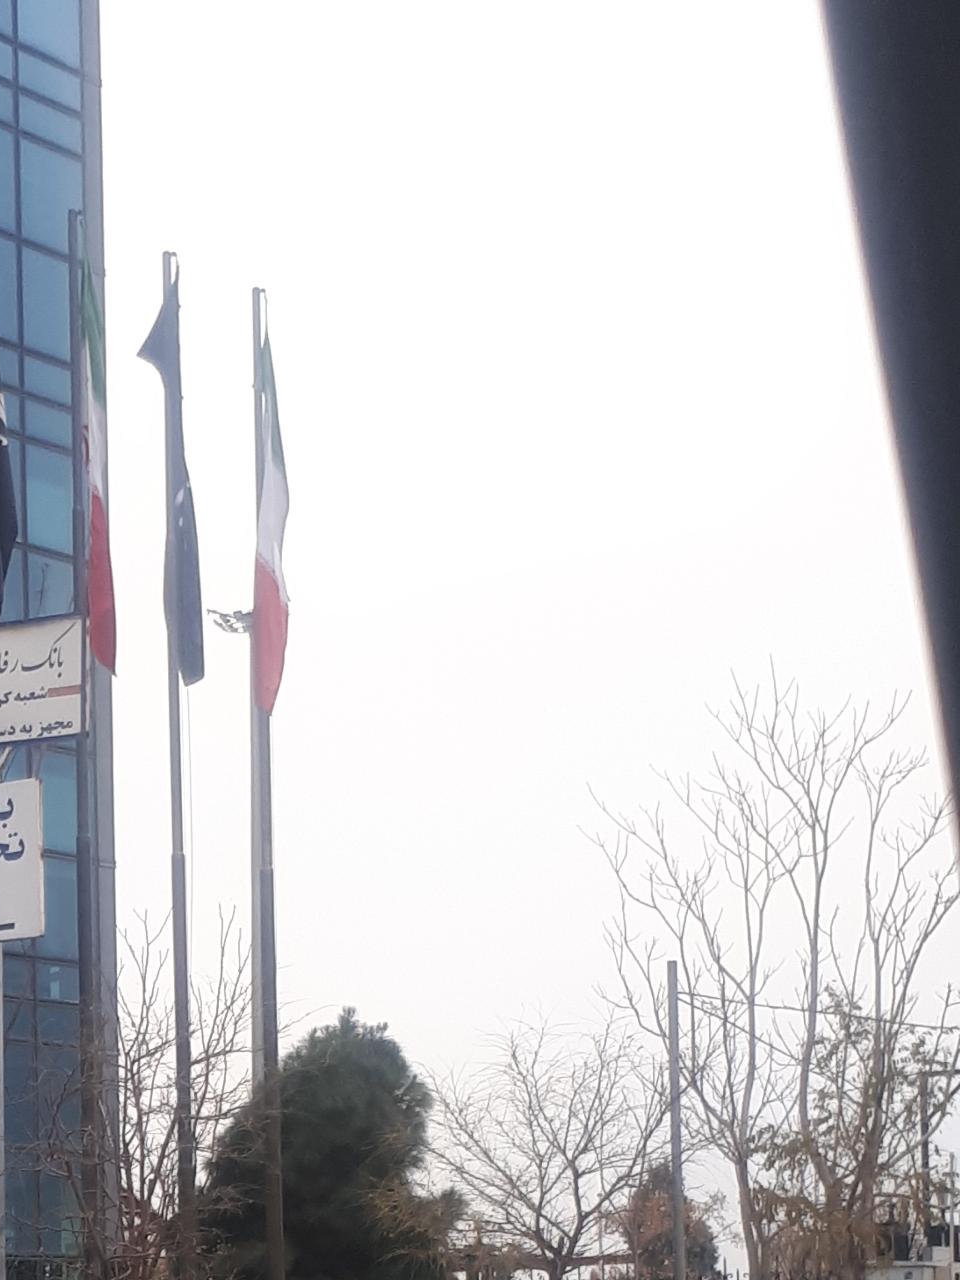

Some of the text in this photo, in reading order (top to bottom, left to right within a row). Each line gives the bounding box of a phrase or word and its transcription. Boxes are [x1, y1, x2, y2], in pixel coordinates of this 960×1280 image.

[21, 622, 76, 678] بانک
[14, 687, 48, 703] شعبه
[19, 724, 33, 737] به
[37, 719, 73, 737] مجهز
